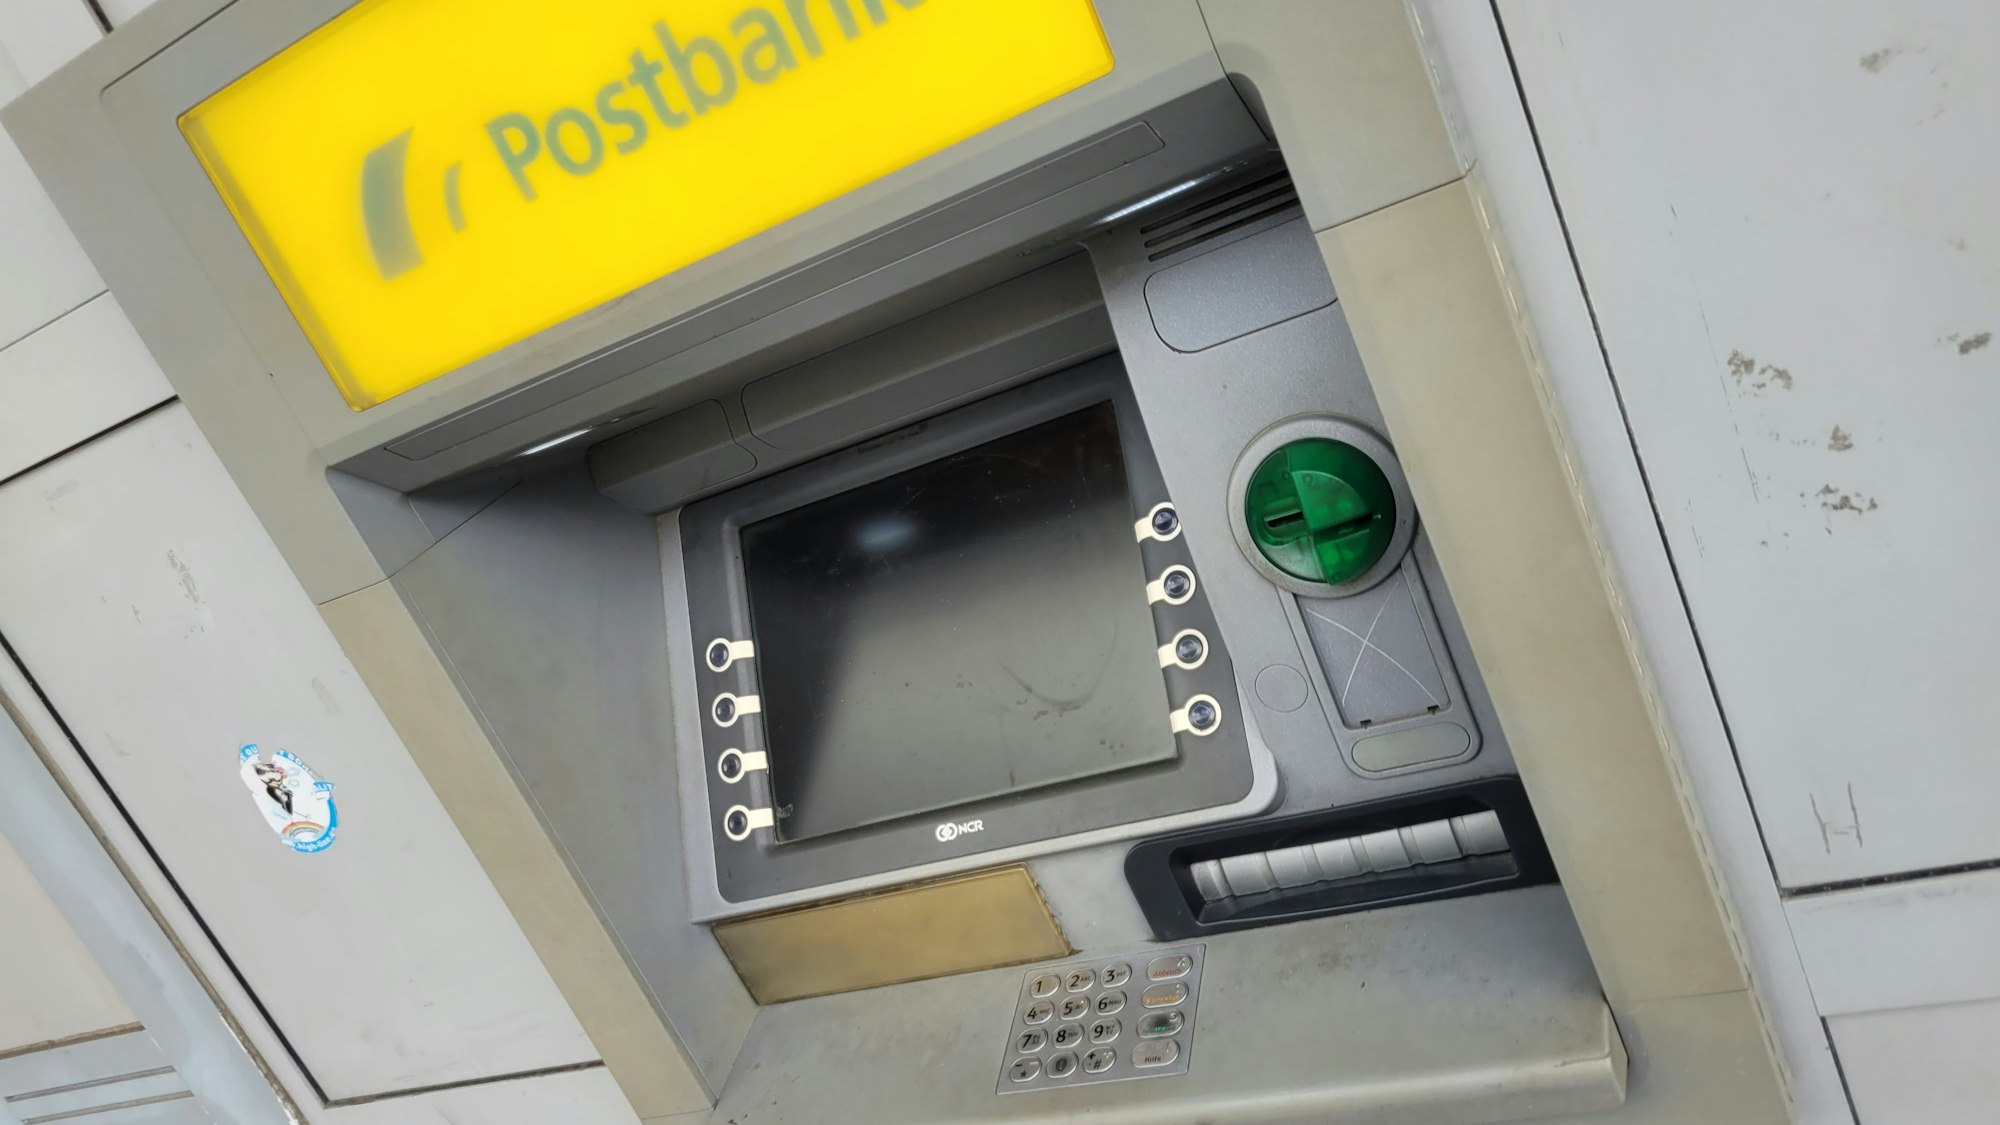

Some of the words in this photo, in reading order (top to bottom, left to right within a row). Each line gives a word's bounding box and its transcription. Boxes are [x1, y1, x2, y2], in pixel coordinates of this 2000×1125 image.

[484, 0, 926, 202] Postban
[958, 820, 985, 835] NCR
[1069, 974, 1080, 988] 2
[1105, 969, 1116, 983] 3
[1036, 981, 1043, 993] 1
[1063, 1001, 1074, 1016] 5
[1098, 997, 1109, 1011] 6
[1027, 1006, 1038, 1020] 4
[1056, 1029, 1067, 1043] 8
[1094, 1024, 1105, 1039] 9
[1023, 1033, 1033, 1048] 7
